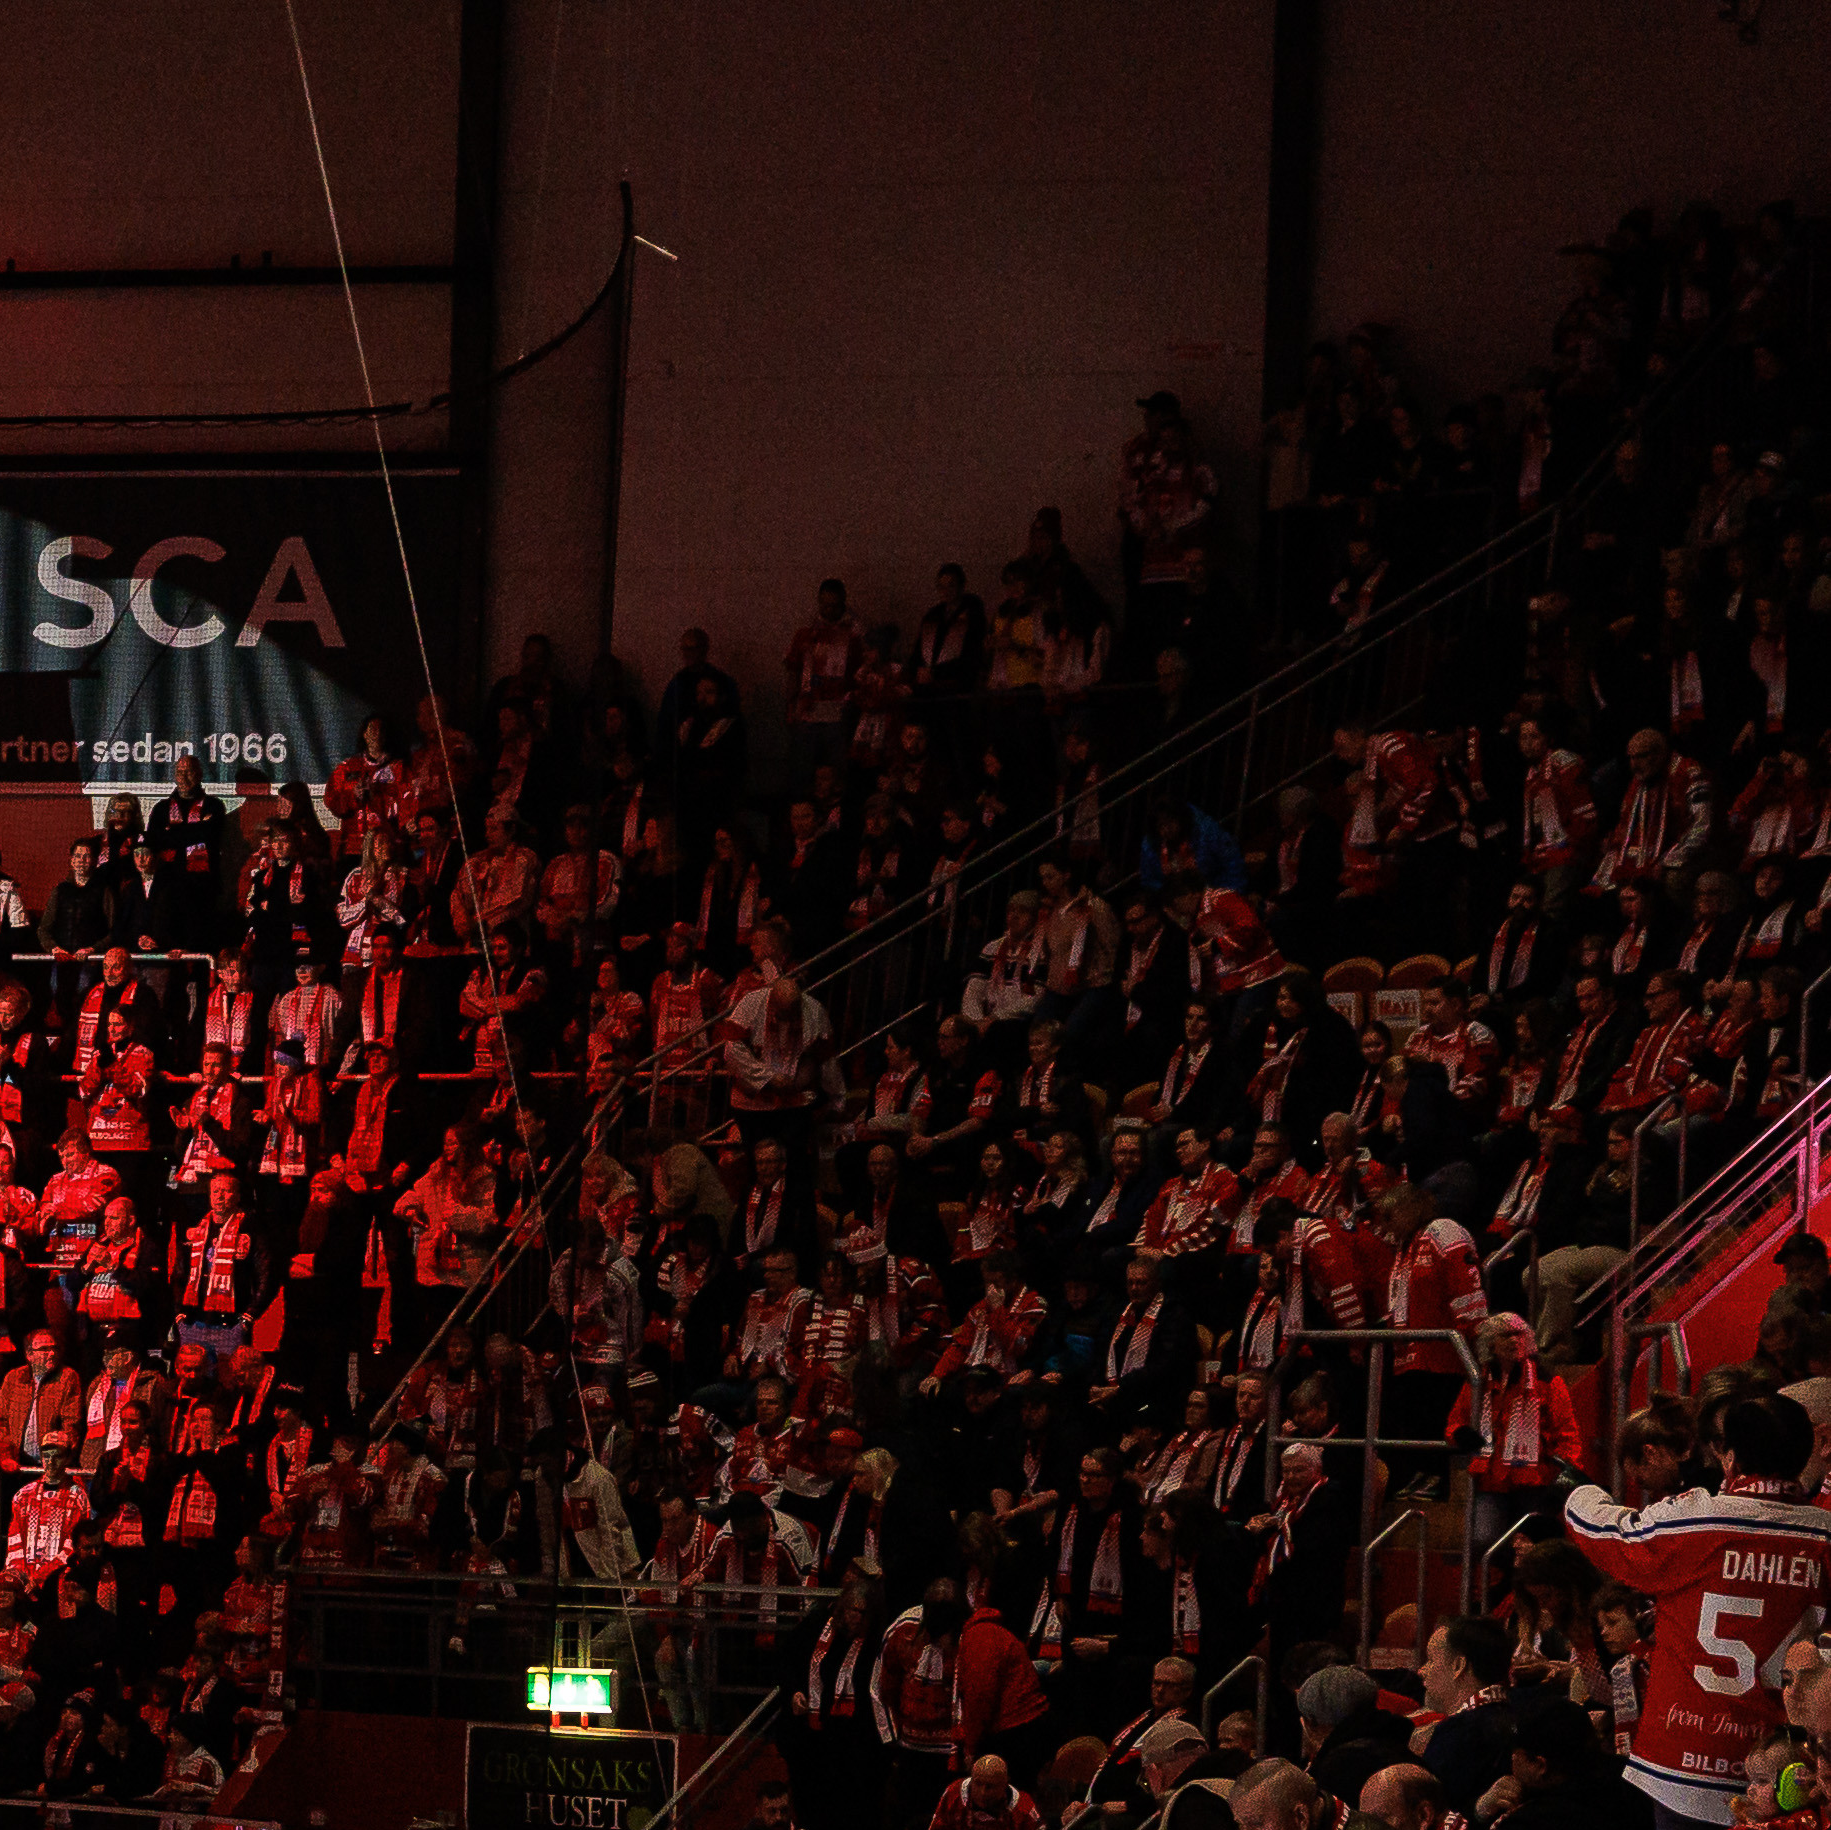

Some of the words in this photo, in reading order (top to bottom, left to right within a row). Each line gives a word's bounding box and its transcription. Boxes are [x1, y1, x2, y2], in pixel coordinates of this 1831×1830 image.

[33, 535, 347, 648] SCA
[92, 733, 194, 764] sedan
[204, 733, 287, 764] 1966
[1723, 1549, 1822, 1591] DAHLÉN
[524, 1791, 628, 1830] HUSET
